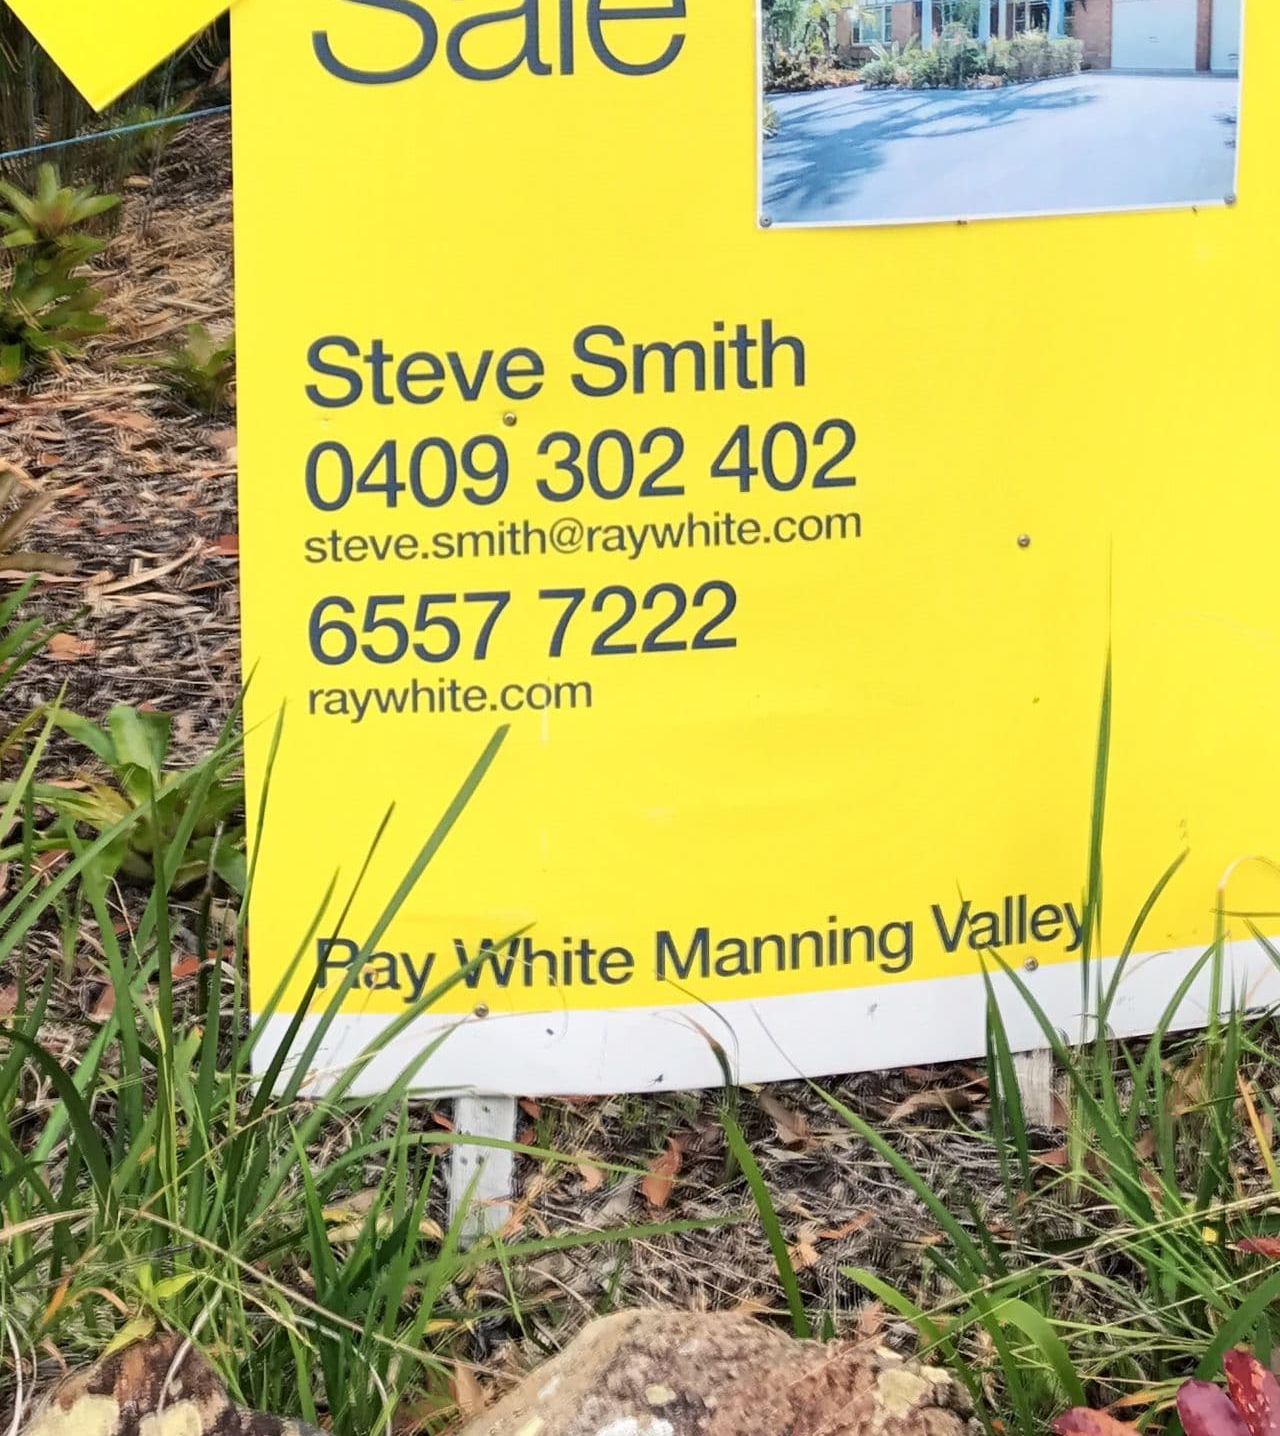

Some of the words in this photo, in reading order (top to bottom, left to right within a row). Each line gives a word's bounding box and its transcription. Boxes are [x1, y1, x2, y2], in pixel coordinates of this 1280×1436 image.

[304, 334, 546, 408] Steve
[570, 318, 807, 398] Smith
[304, 434, 509, 512] 0409
[536, 427, 686, 504] 302
[709, 418, 858, 494] 402
[304, 509, 863, 564] steve.smith@raywhite.com
[308, 591, 511, 666] 6557
[538, 580, 739, 659] 7222
[308, 676, 593, 724] raywhite.com
[317, 937, 436, 1004] Ray
[453, 935, 635, 988] White
[656, 915, 914, 982] Manning
[931, 893, 1090, 954] Valley
